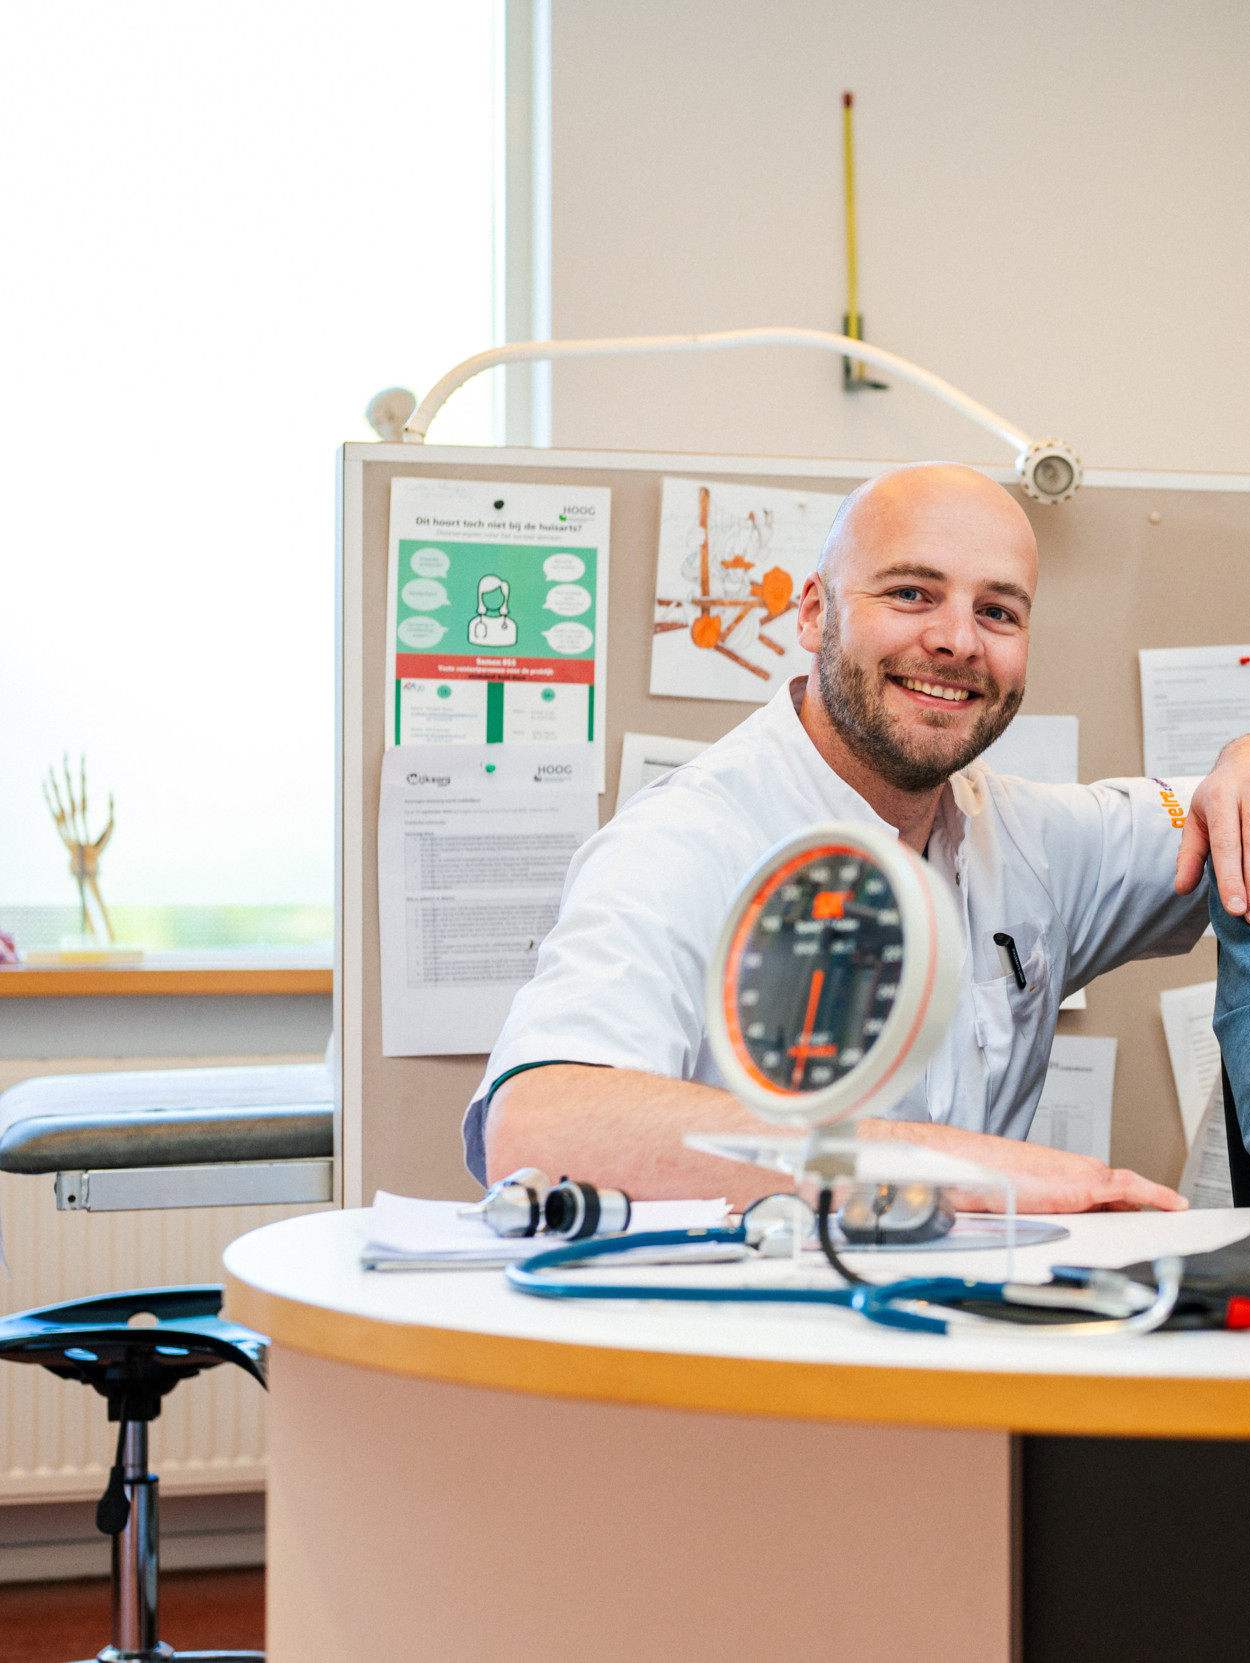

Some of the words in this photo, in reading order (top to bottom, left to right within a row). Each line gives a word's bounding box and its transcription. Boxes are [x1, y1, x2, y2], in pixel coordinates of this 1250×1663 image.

[563, 505, 596, 516] HOOG
[416, 516, 430, 526] Dit
[433, 518, 460, 527] hoort
[463, 519, 484, 528] toch
[487, 520, 507, 529] niet
[509, 521, 522, 531] bij
[524, 521, 536, 530] de
[539, 522, 582, 533] huisarts?
[538, 764, 572, 775] HOOG
